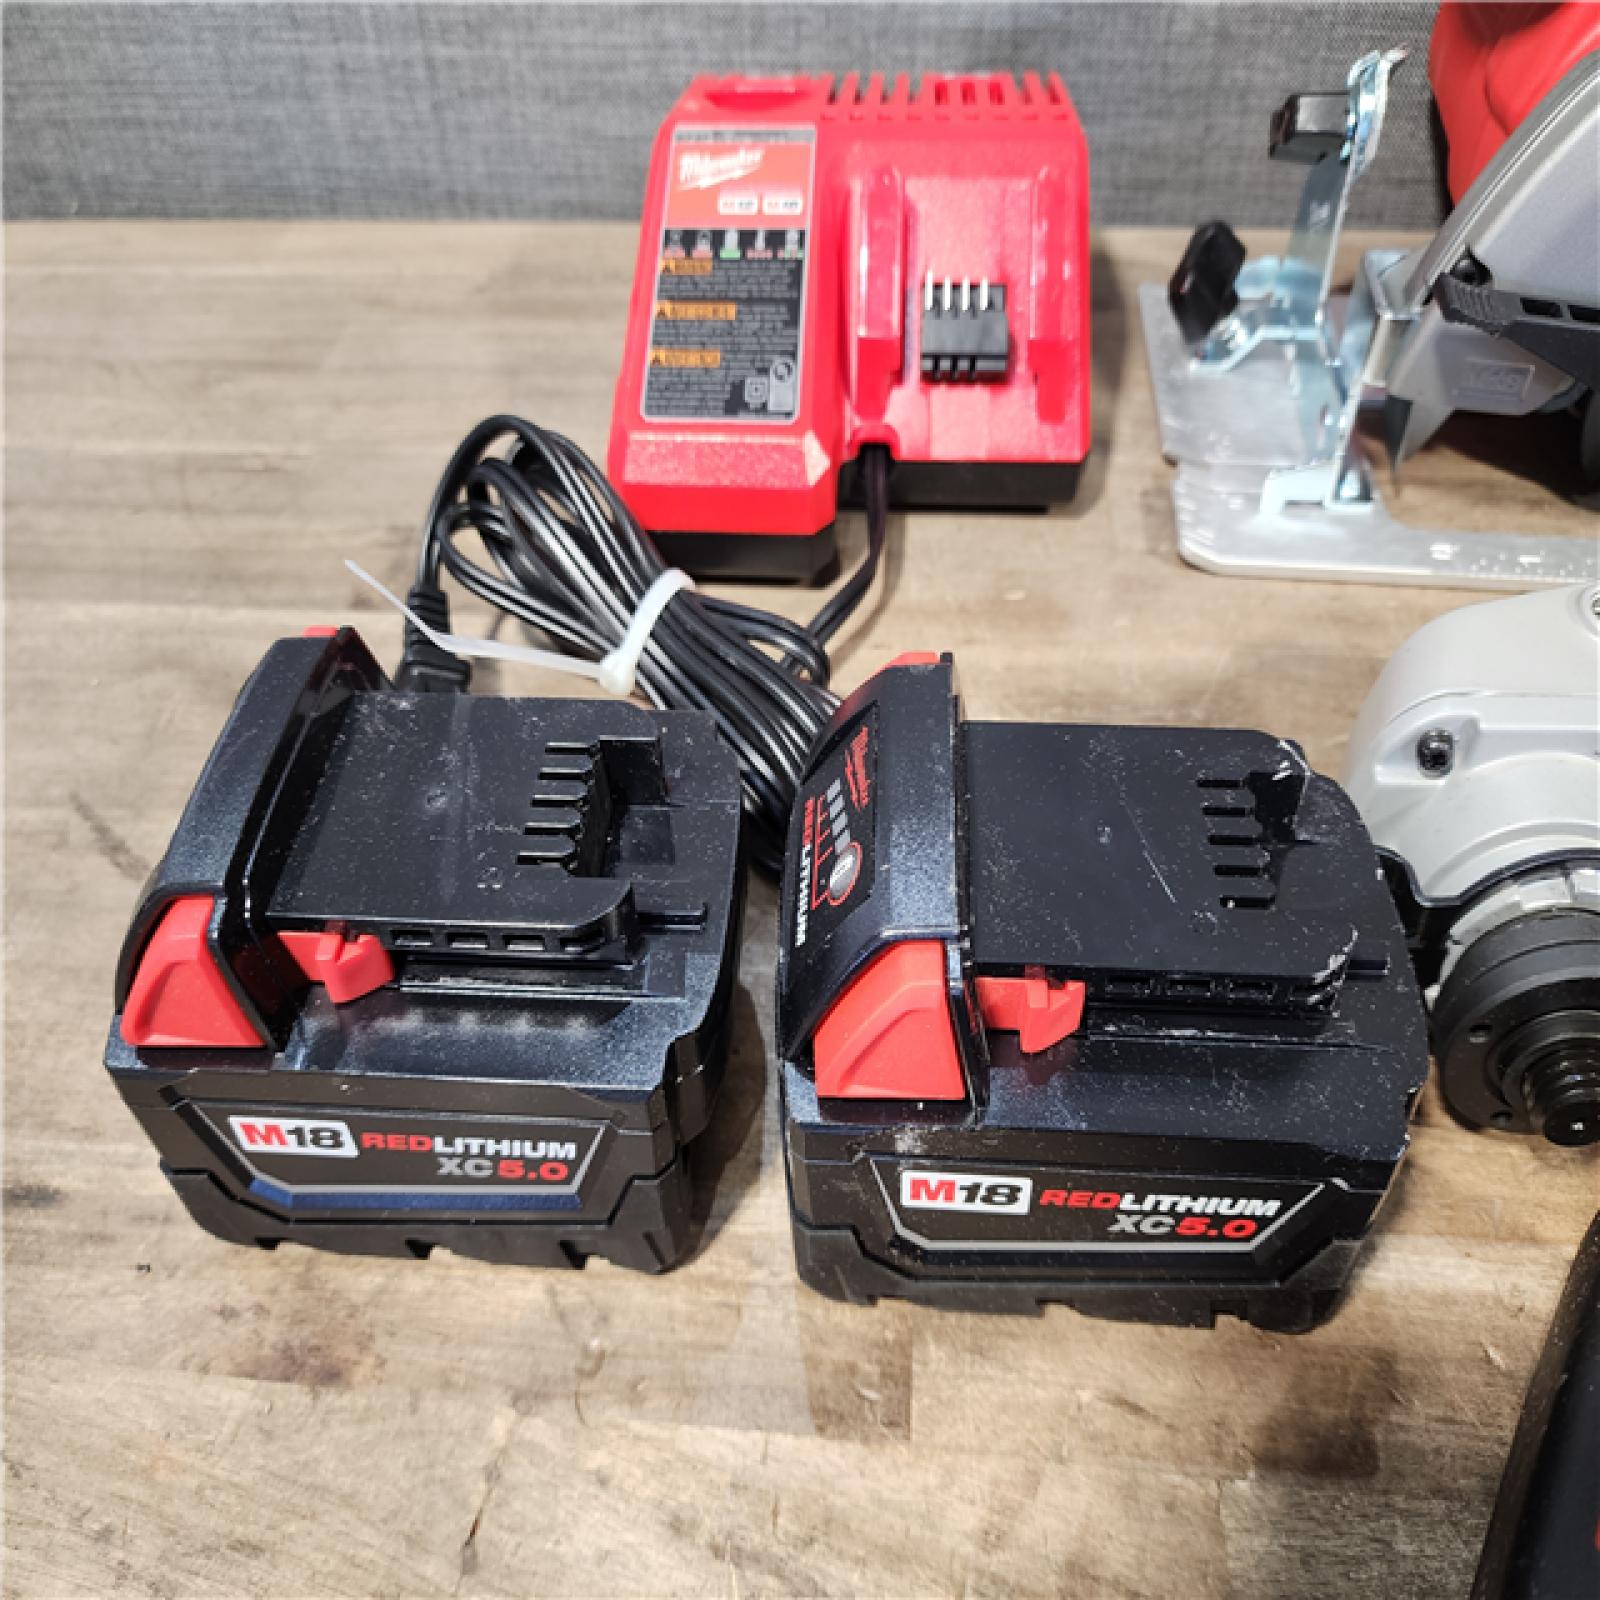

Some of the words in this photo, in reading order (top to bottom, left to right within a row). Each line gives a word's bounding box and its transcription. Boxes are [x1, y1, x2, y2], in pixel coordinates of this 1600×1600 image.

[239, 1121, 344, 1150] M18
[361, 1132, 576, 1161] REDLITHIUM
[909, 1177, 1024, 1206] M18
[1039, 1189, 1281, 1218] REDLITHIUM
